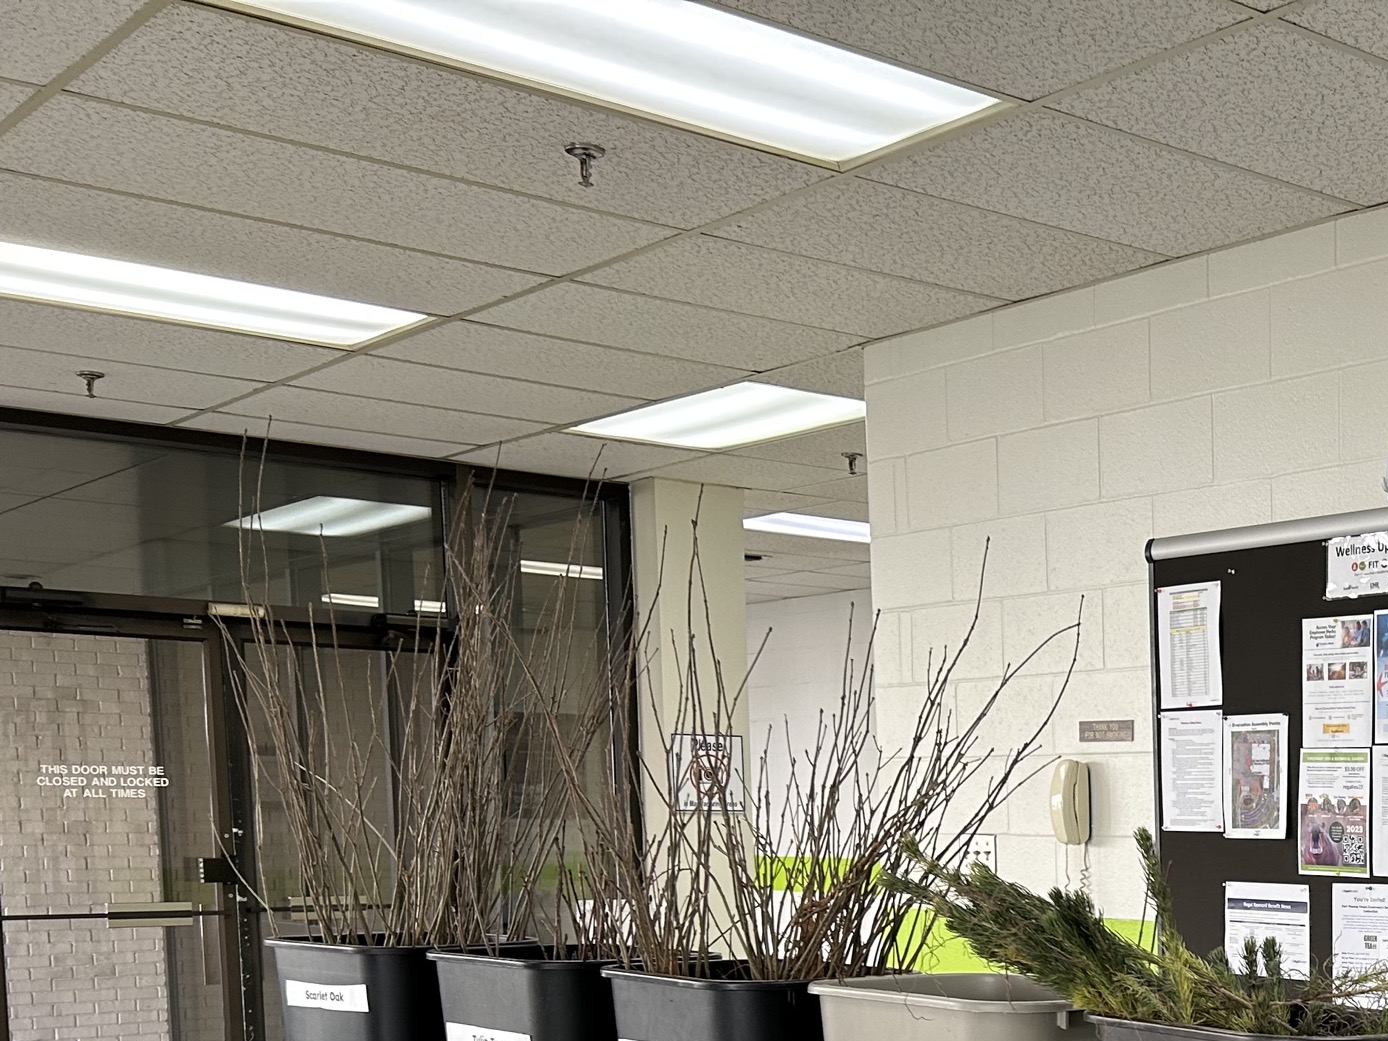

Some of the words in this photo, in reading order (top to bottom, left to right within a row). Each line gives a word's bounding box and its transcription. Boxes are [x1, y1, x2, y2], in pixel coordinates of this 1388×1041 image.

[1335, 544, 1375, 557] Wellness
[1368, 560, 1379, 569] FIT
[40, 765, 68, 774] THIS
[72, 765, 108, 775] DOOR
[112, 766, 145, 775] MUST
[149, 766, 165, 775] BE
[36, 777, 87, 786] CLOSED
[92, 777, 117, 786] AND
[121, 777, 169, 787] LOCKED
[63, 788, 78, 798] AT
[83, 789, 106, 798] ALL
[110, 789, 146, 798] TIMES
[1346, 825, 1364, 834] 2023
[1363, 934, 1378, 943] GREEN
[305, 989, 329, 1002] Scarlet
[330, 991, 345, 1002] Oak
